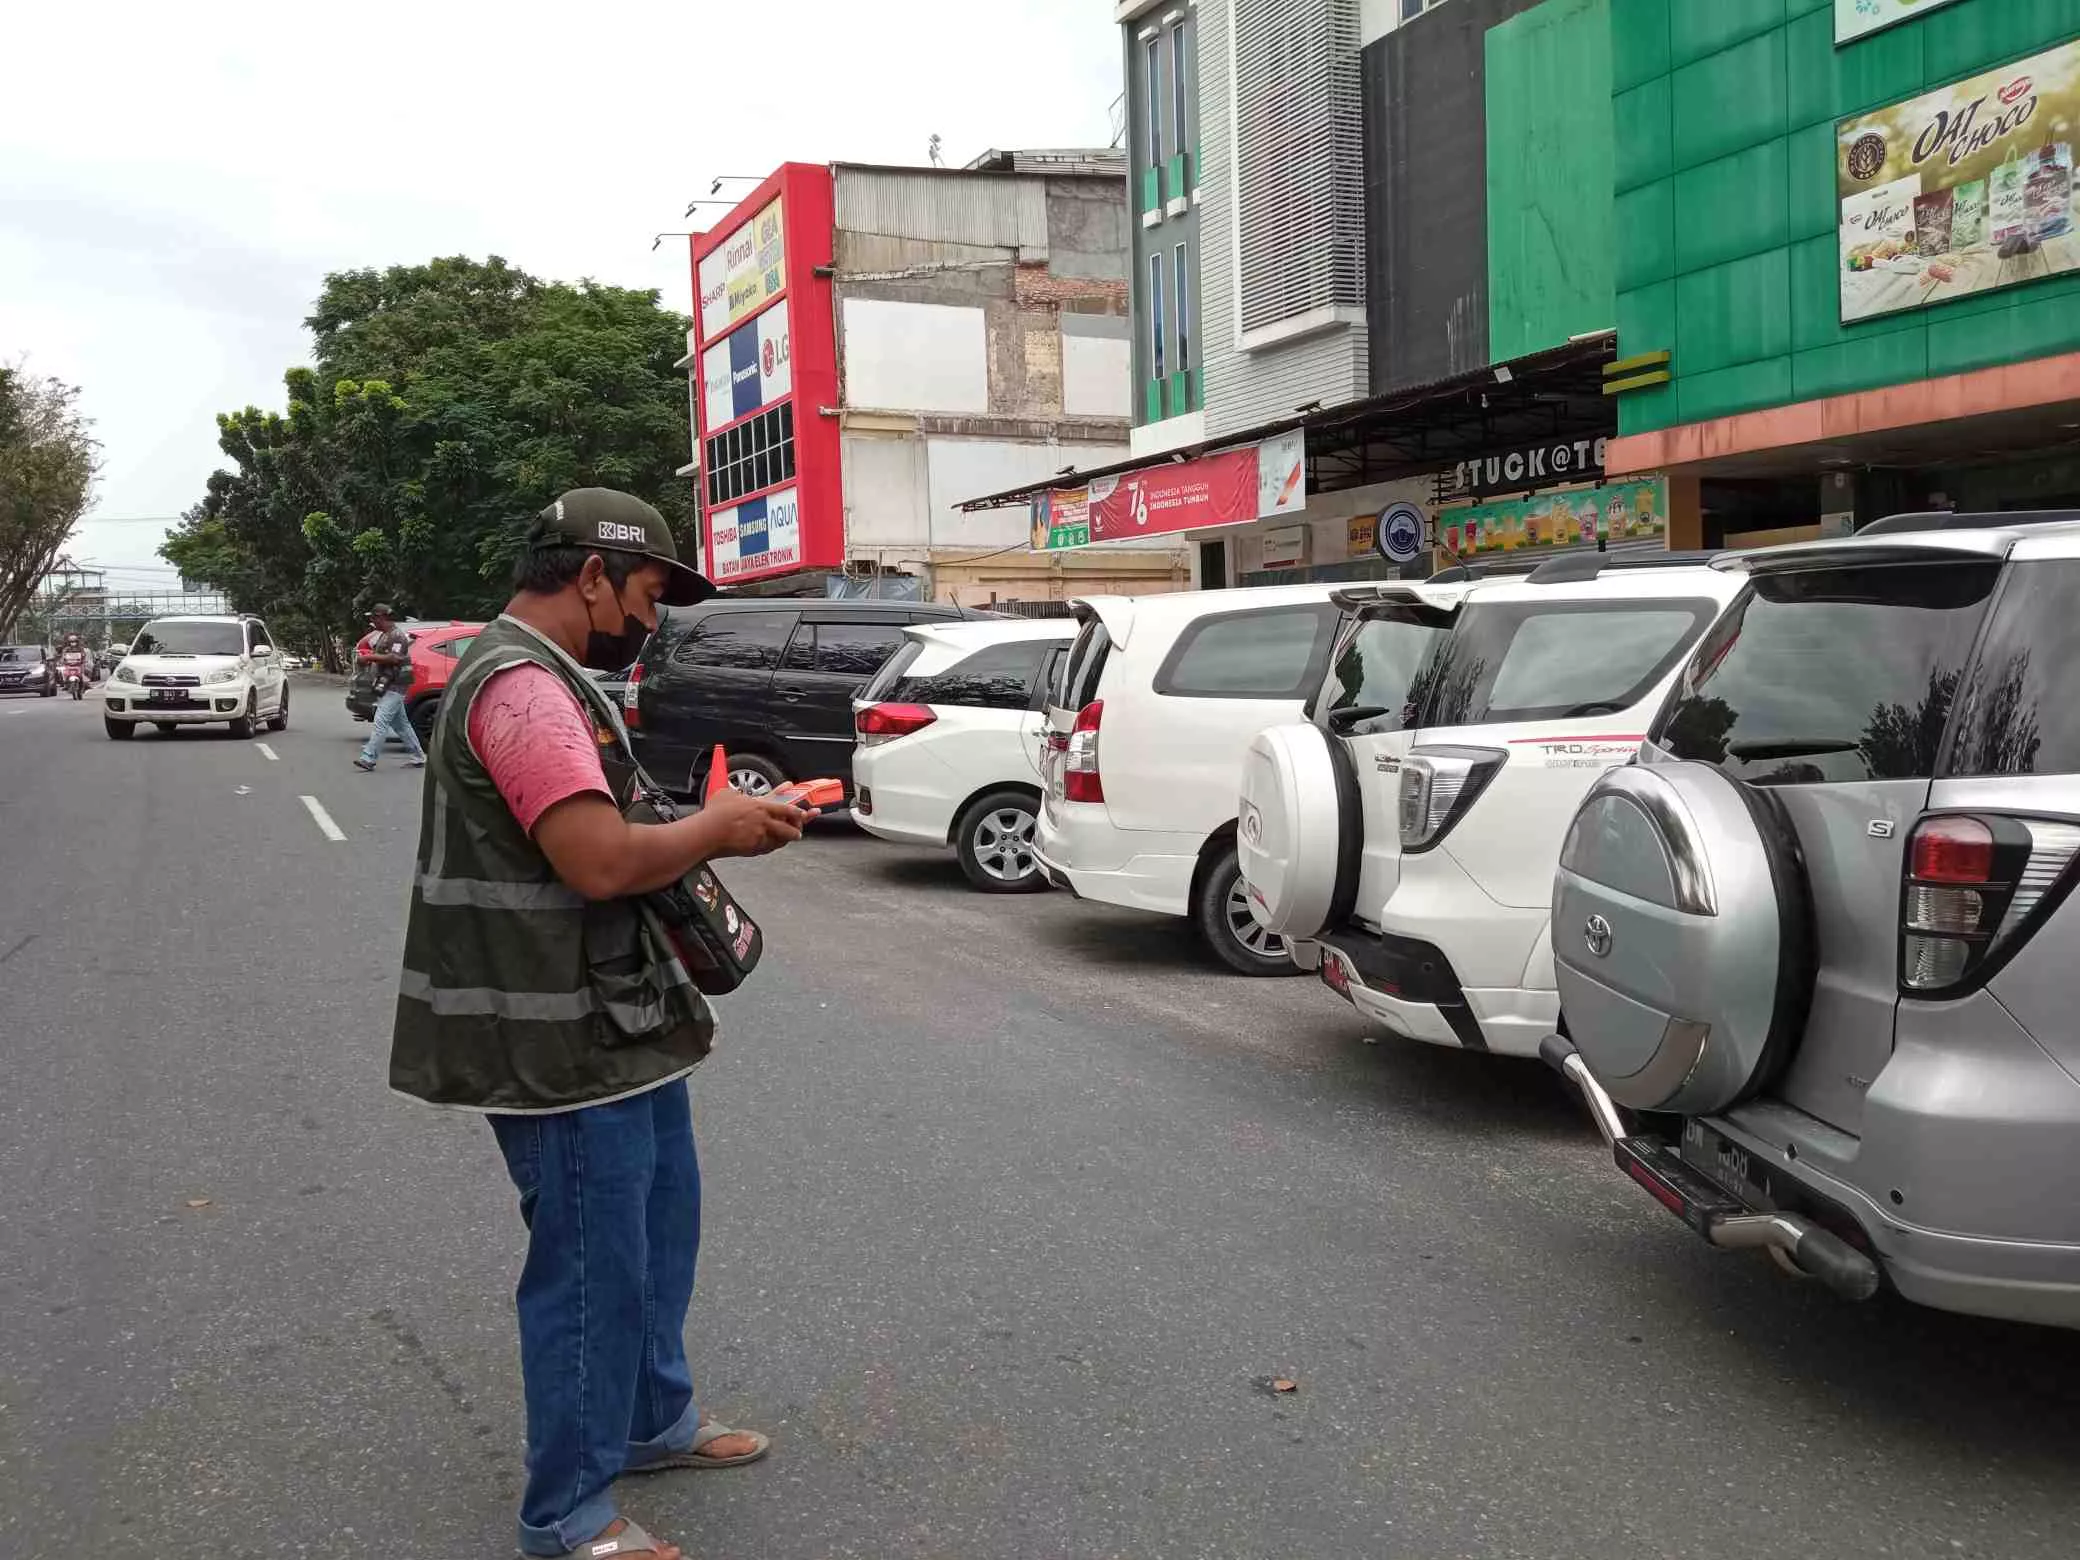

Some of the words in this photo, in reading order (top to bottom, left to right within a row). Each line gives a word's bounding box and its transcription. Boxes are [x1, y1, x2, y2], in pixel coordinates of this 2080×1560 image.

[1912, 95, 1988, 164] OAT
[1948, 96, 2037, 165] CHOCO
[727, 234, 753, 272] Rinnai
[702, 282, 726, 309] SHARP
[776, 333, 789, 366] LG
[732, 361, 758, 384] Panasonic
[740, 518, 767, 539] SAMSUNG
[770, 502, 798, 530] AQUA
[617, 525, 645, 543] BRI
[713, 527, 737, 546] TOSHIBA
[1540, 744, 1583, 754] TRD
[1869, 820, 1893, 838] S
